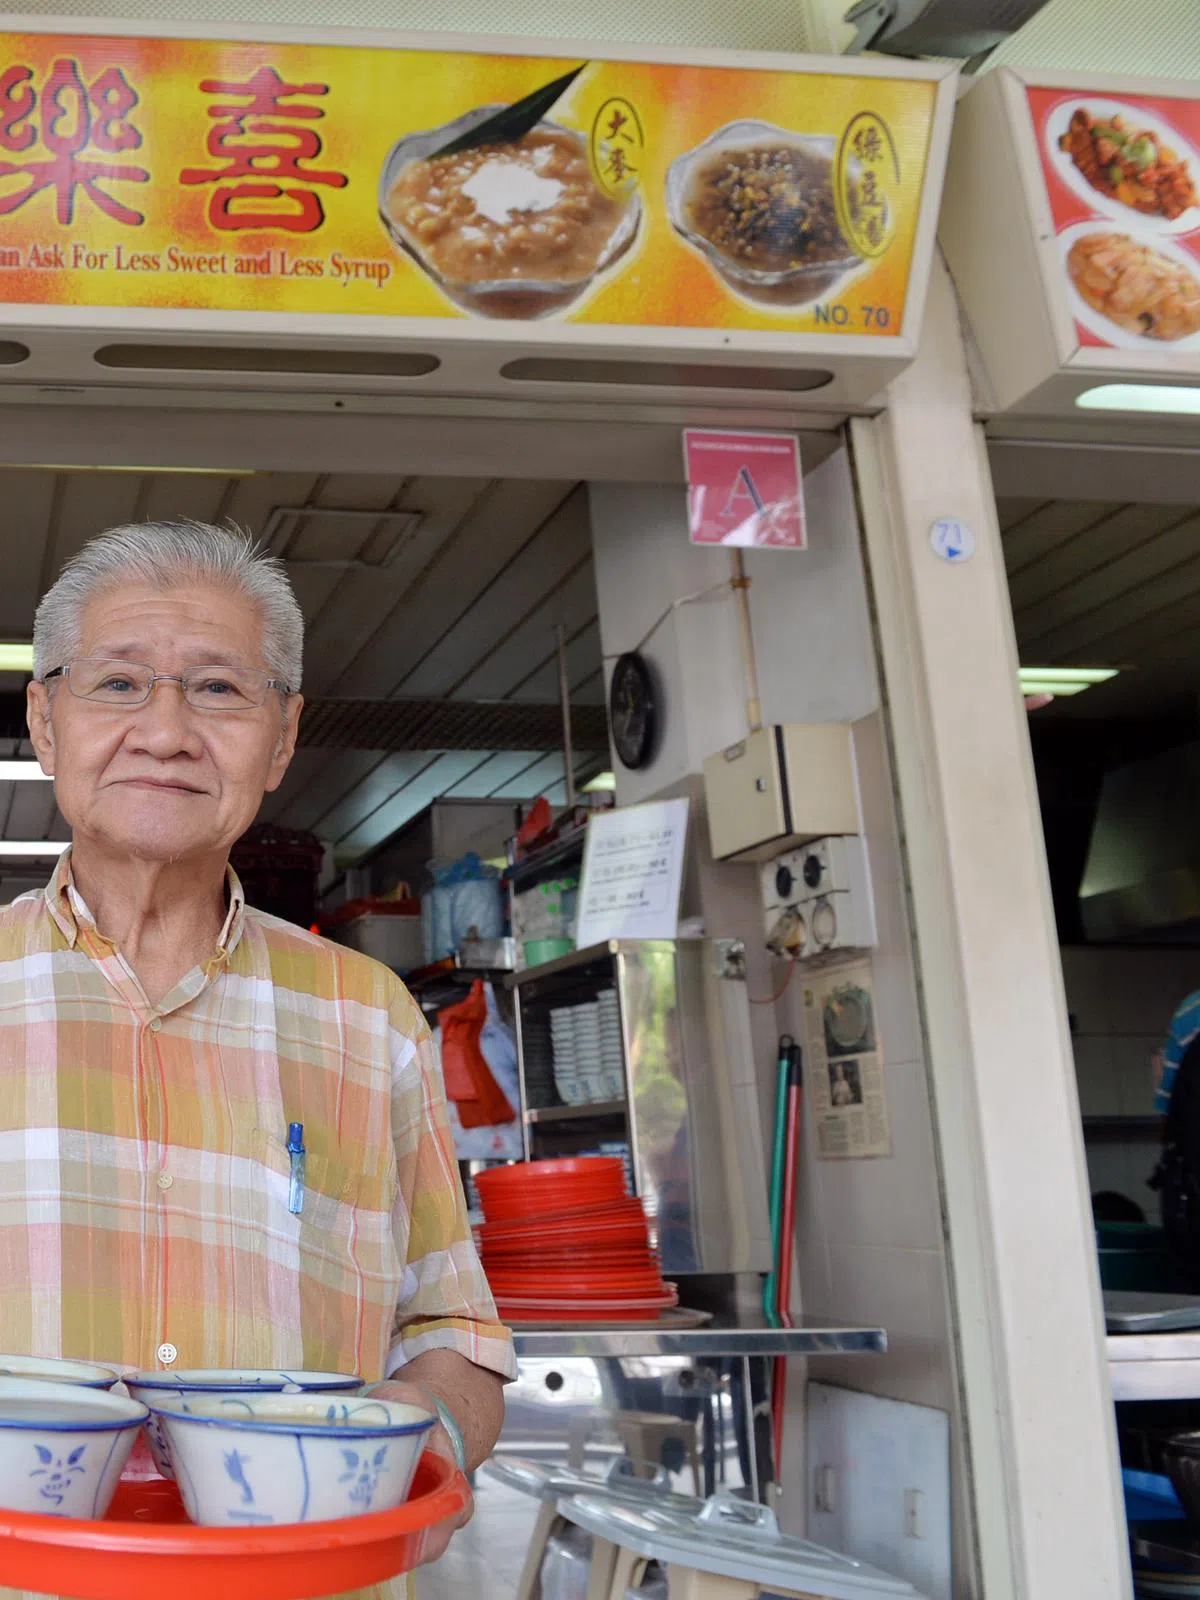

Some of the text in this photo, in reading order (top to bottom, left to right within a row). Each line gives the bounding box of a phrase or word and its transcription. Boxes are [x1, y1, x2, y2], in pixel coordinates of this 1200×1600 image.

[29, 243, 65, 269] Ask
[72, 243, 109, 269] For
[116, 245, 161, 272] Less
[167, 248, 228, 274] Sweet
[234, 251, 272, 276] and
[280, 251, 325, 277] Less
[330, 252, 391, 288] Syrup
[815, 305, 891, 328] NO. 70
[720, 465, 768, 519] A
[936, 523, 963, 545] 71
